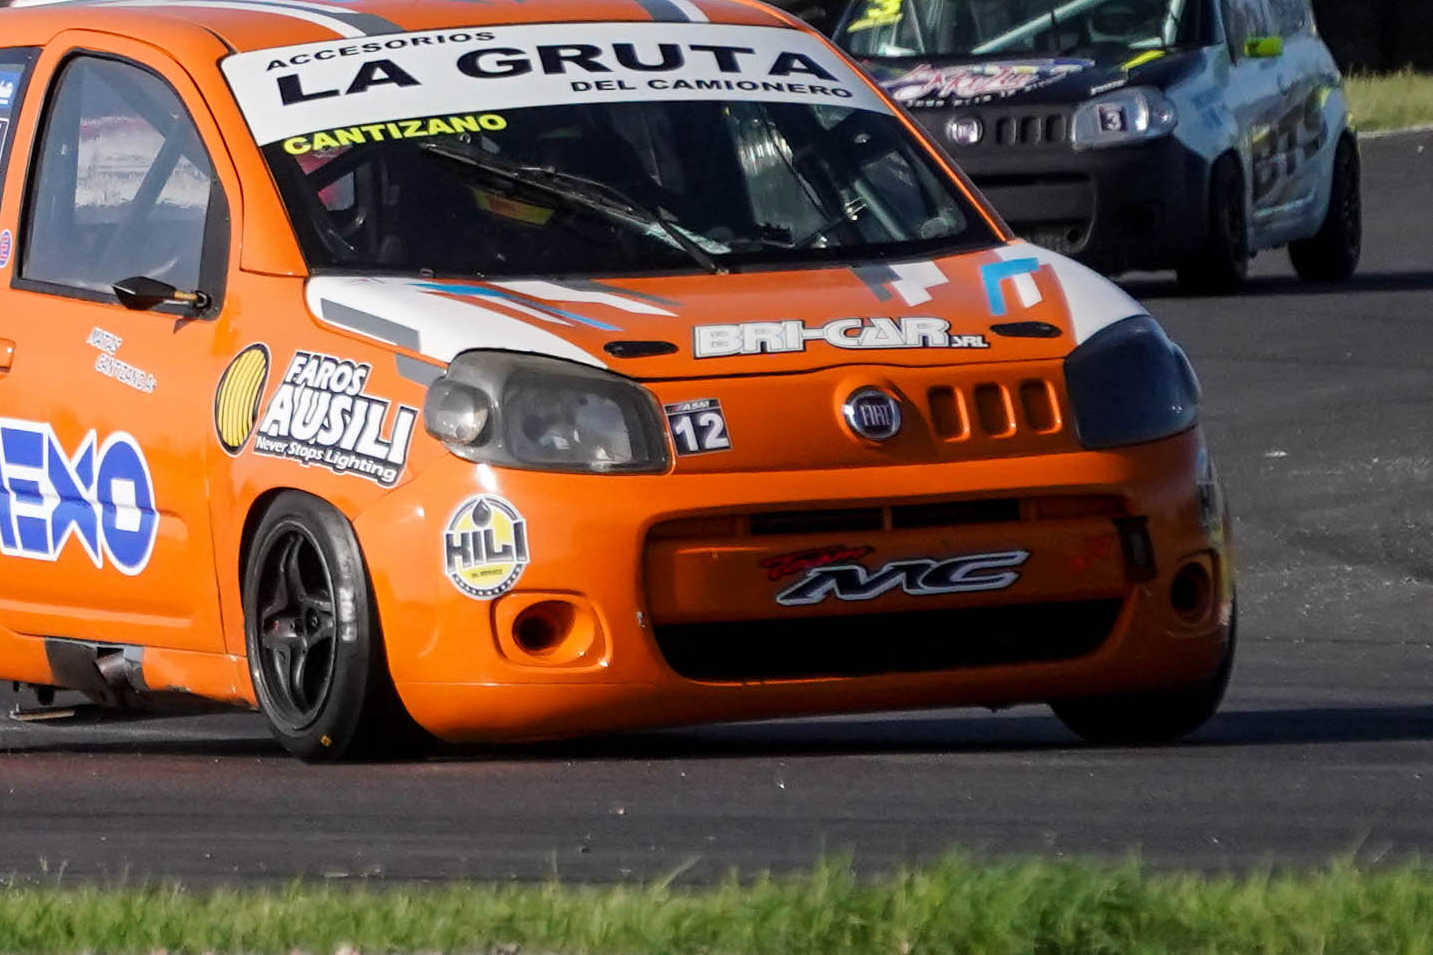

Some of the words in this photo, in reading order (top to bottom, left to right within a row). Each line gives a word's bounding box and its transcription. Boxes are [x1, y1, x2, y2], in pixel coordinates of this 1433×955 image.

[266, 31, 496, 72] ACCESORIOS
[276, 58, 422, 106] LA
[456, 42, 841, 82] GRUTA
[570, 80, 637, 92] DEL
[647, 78, 854, 98] CAMIONERO
[284, 113, 508, 155] CANTIZANO
[1105, 111, 1121, 131] 3
[693, 316, 951, 359] BRI-CAR
[951, 334, 990, 348] SRL
[285, 353, 368, 396] FAROS
[259, 383, 417, 465] AUSILI
[674, 412, 730, 452] 12
[859, 403, 891, 427] FIAT
[256, 437, 287, 454] Never
[287, 441, 323, 462] Stops
[325, 448, 398, 483] Lighting
